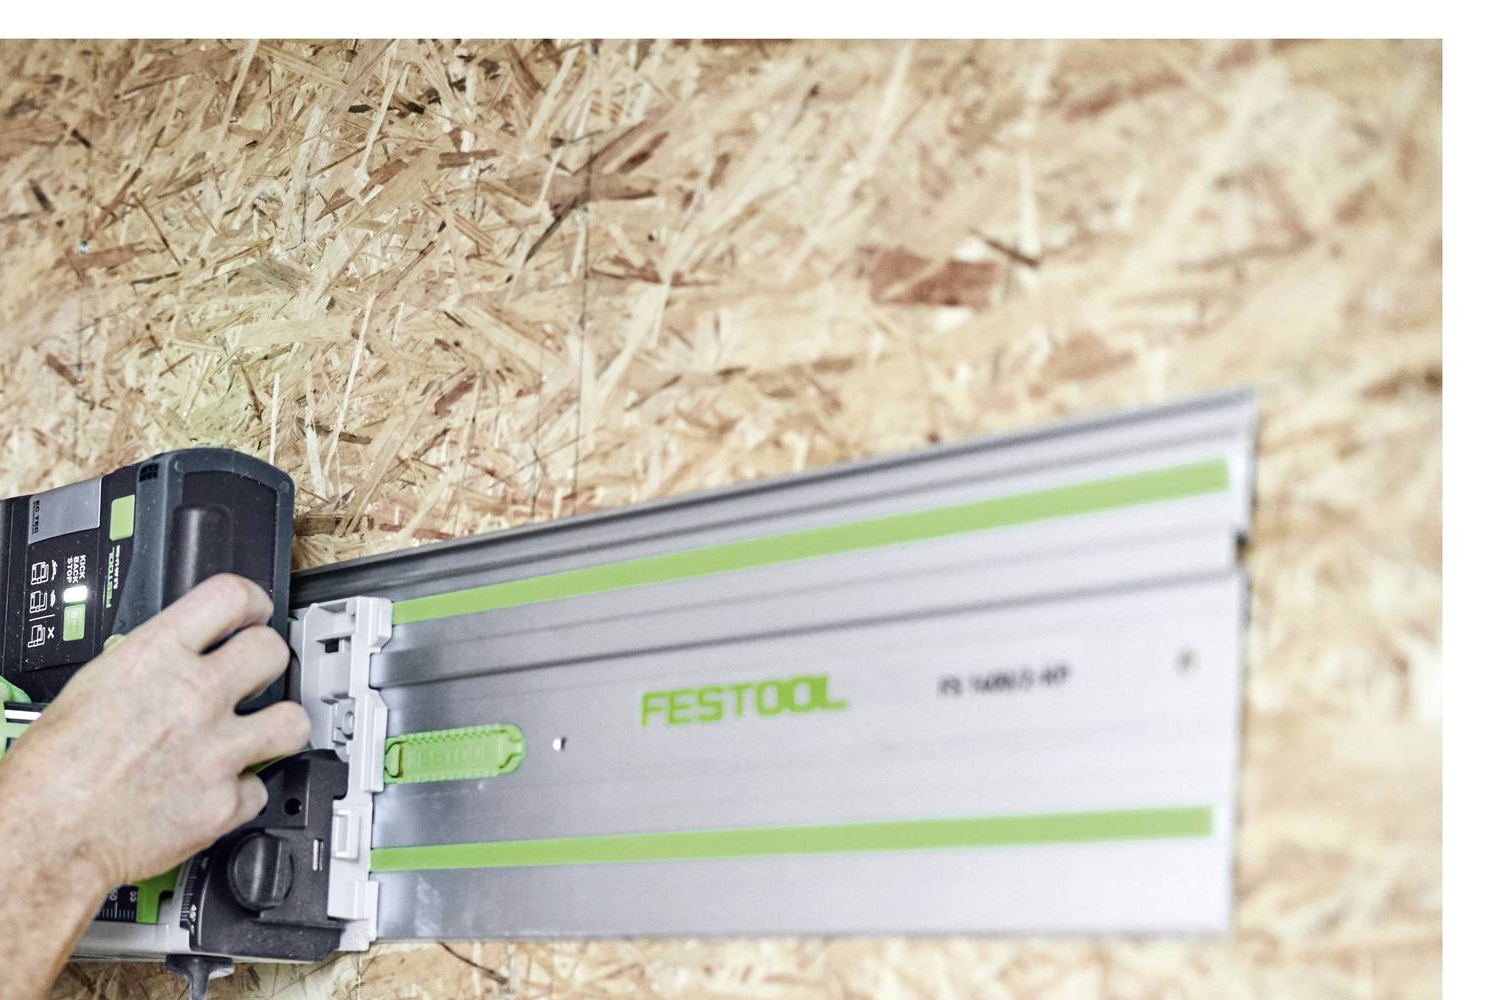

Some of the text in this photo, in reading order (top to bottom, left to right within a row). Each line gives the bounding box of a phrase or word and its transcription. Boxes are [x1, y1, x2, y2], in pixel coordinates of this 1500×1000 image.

[72, 556, 80, 584] BACK
[79, 554, 87, 580] KICK
[106, 546, 115, 608] FESTOOL
[639, 674, 848, 729] FESTOOL
